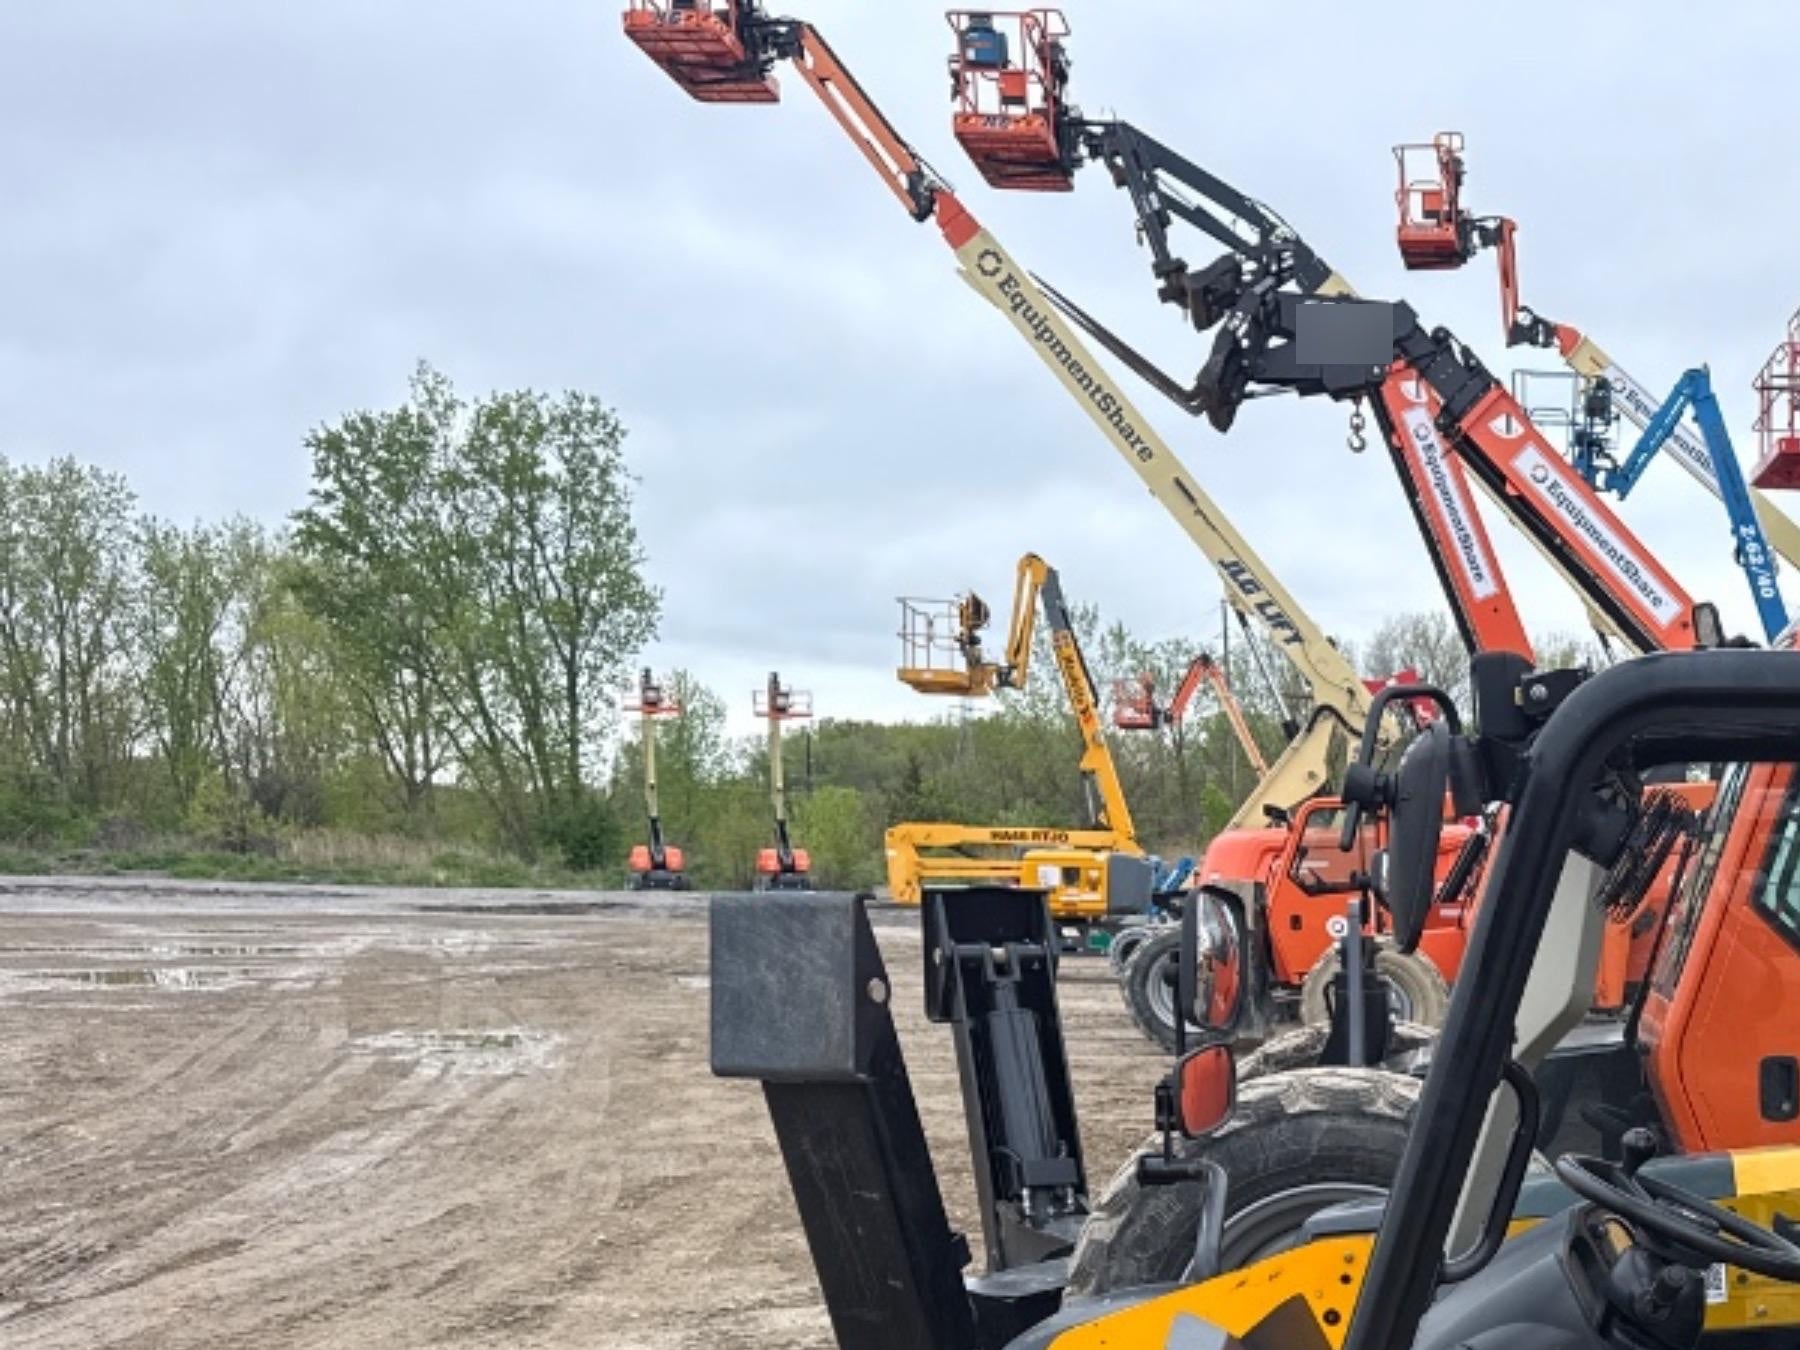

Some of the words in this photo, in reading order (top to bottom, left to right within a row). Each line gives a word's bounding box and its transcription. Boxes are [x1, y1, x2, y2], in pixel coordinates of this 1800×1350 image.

[998, 272, 1154, 462] EquipmentShare
[1421, 440, 1484, 582] EquipmentShare
[1547, 478, 1664, 608] EquipmentShare
[1217, 560, 1262, 595] JLG
[1255, 599, 1304, 645] LIFT
